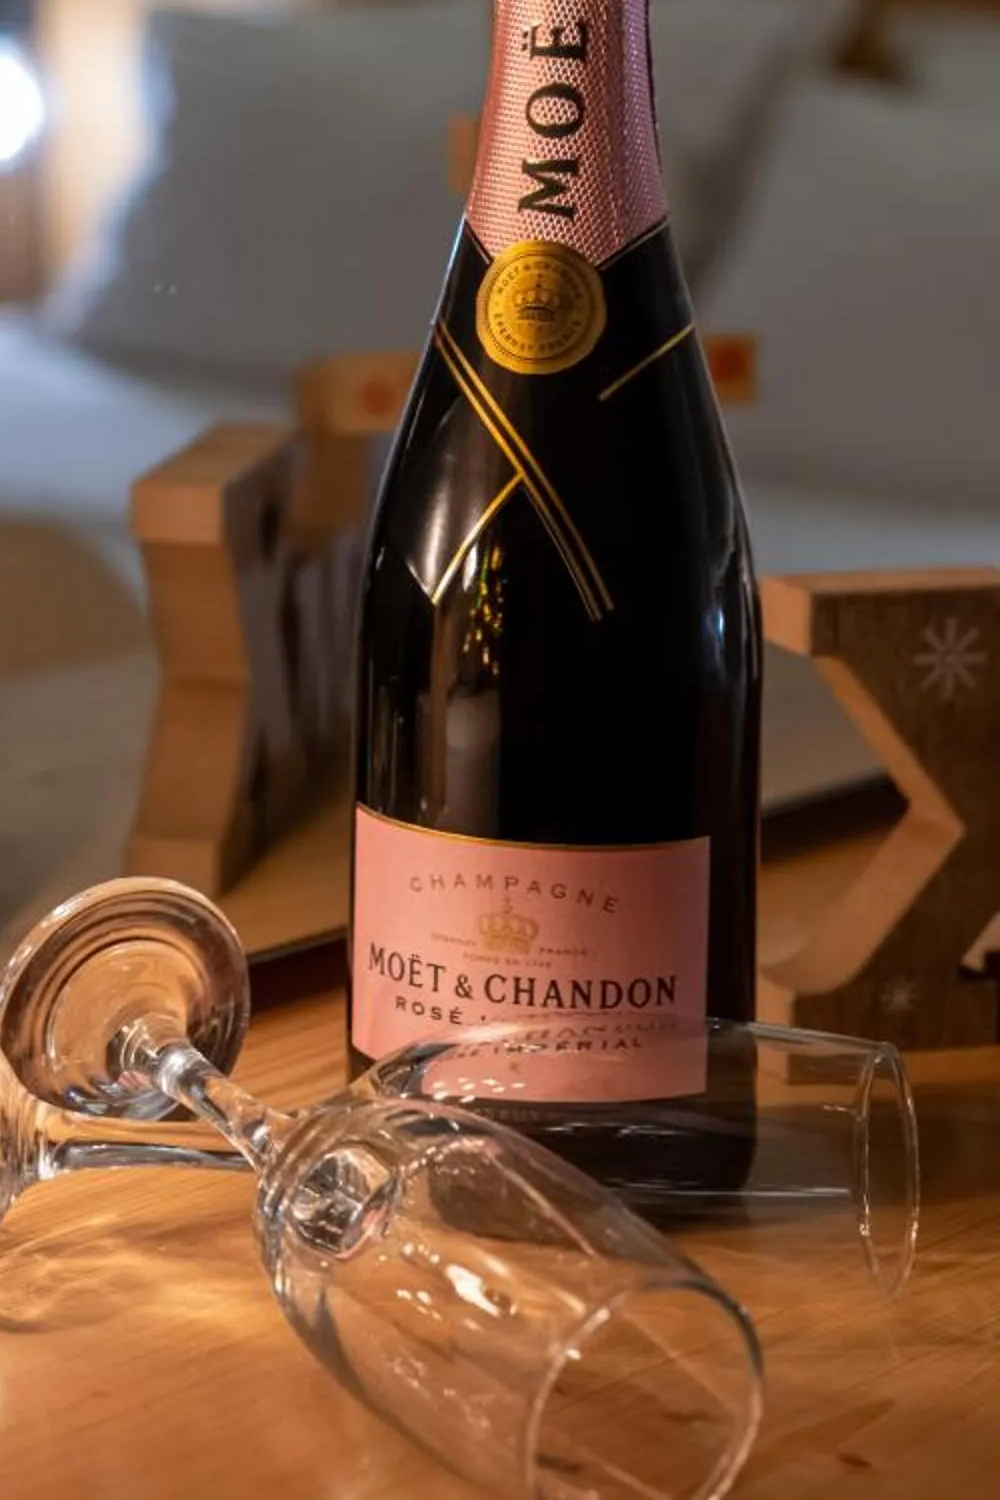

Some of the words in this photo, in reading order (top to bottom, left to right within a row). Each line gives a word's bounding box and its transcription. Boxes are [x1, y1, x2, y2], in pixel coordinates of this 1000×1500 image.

[409, 872, 618, 913] CHAMPAGNE
[368, 941, 446, 993] MOËT
[454, 973, 474, 1000] &
[484, 973, 678, 1010] CHANDON
[395, 995, 463, 1025] ROSÉ
